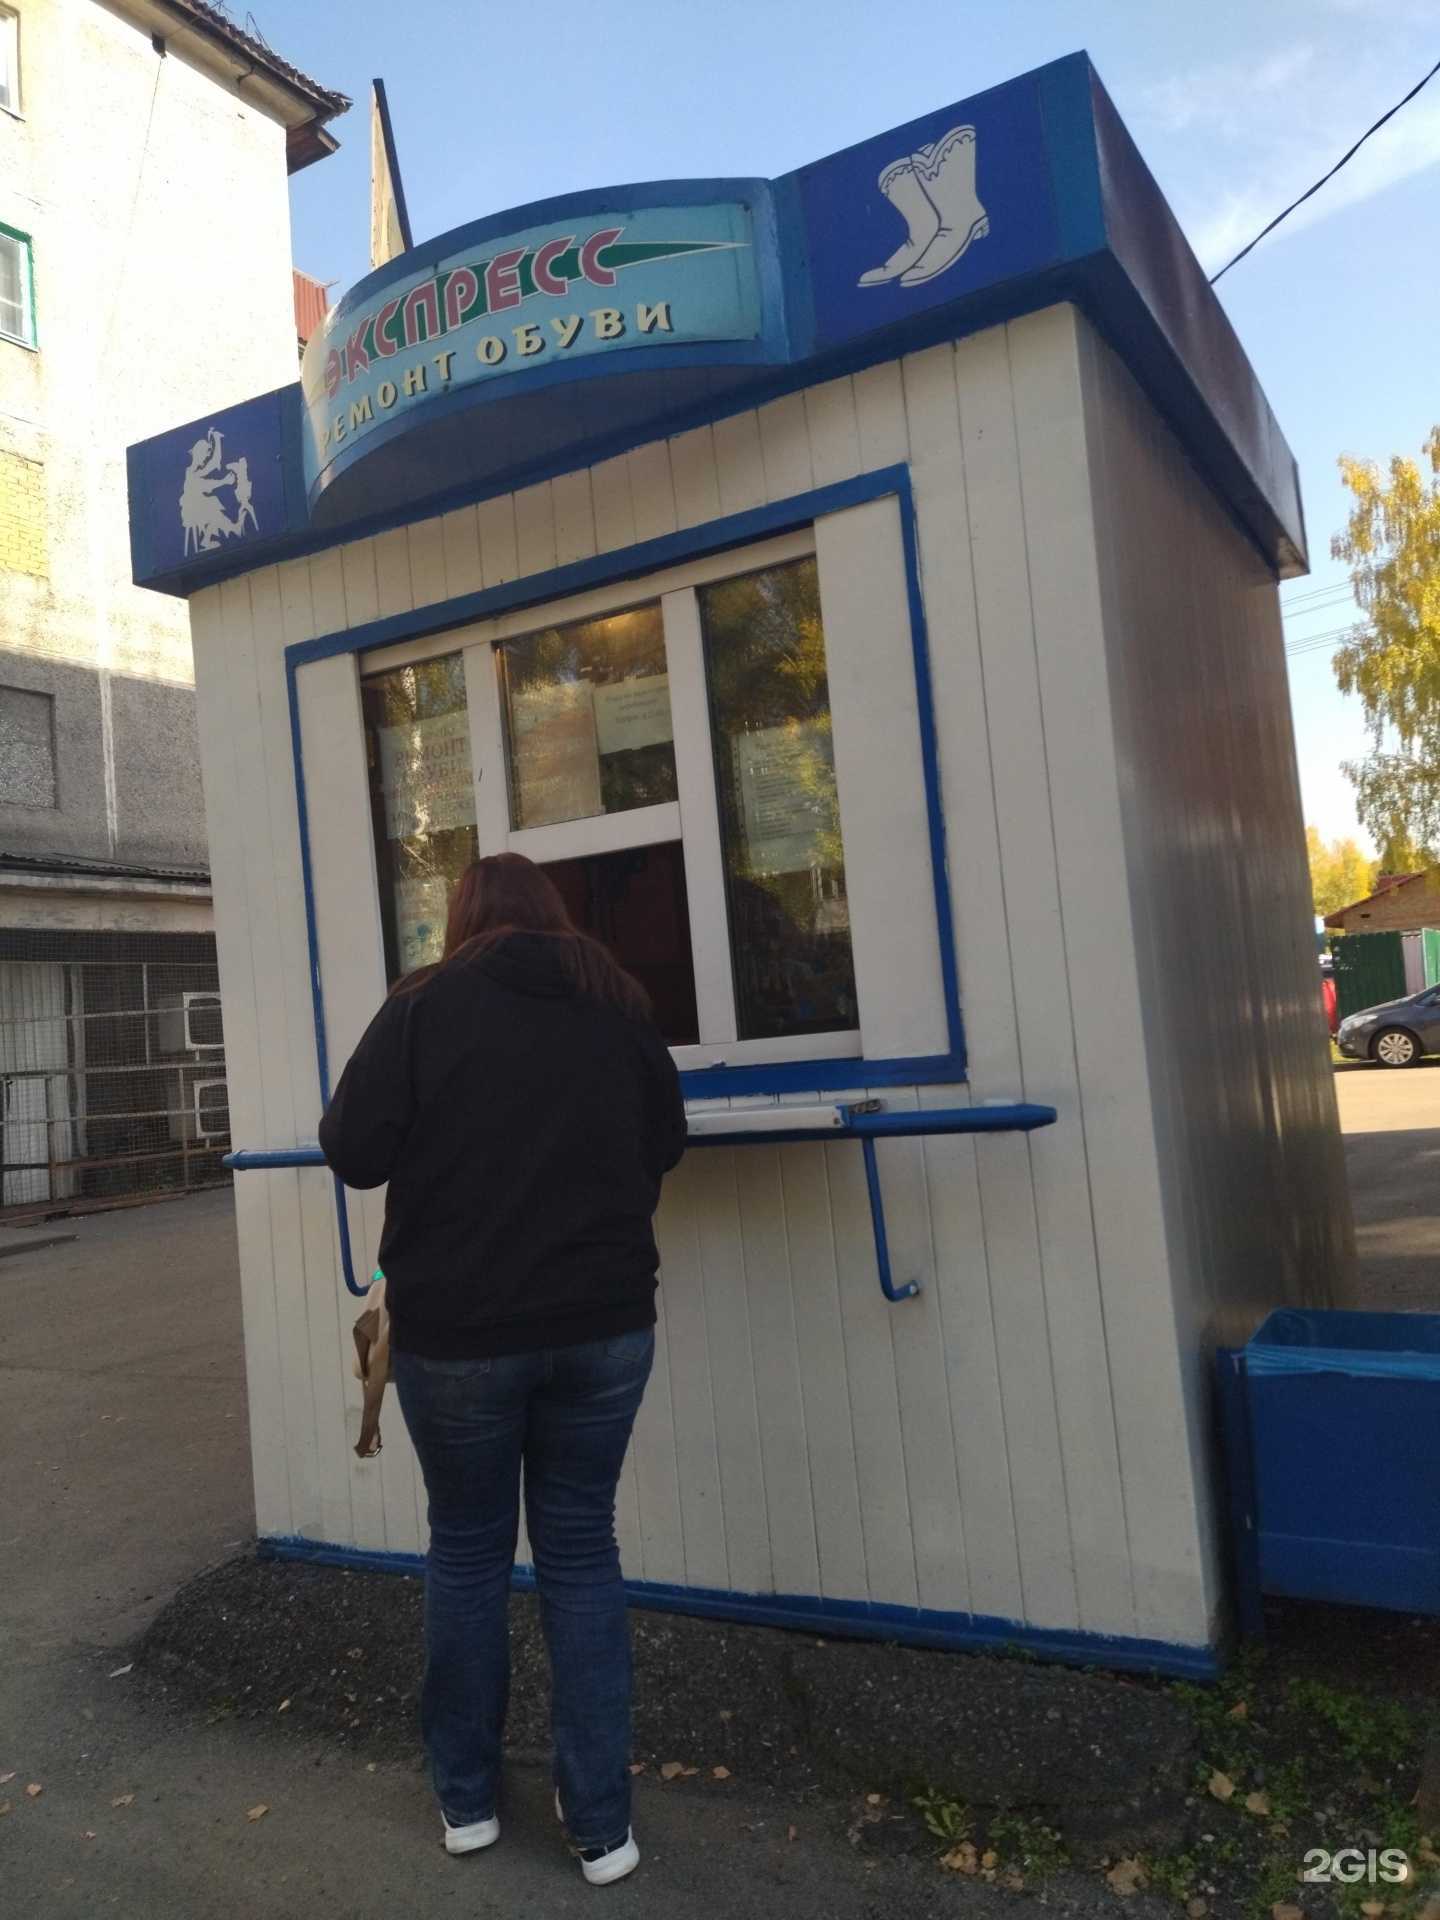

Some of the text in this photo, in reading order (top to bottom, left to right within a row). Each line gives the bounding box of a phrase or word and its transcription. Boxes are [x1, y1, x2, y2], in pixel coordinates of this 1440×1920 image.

[319, 301, 674, 457] РЕМОНТ ОБУВИ
[323, 227, 626, 398] ЭКСПРЕСС
